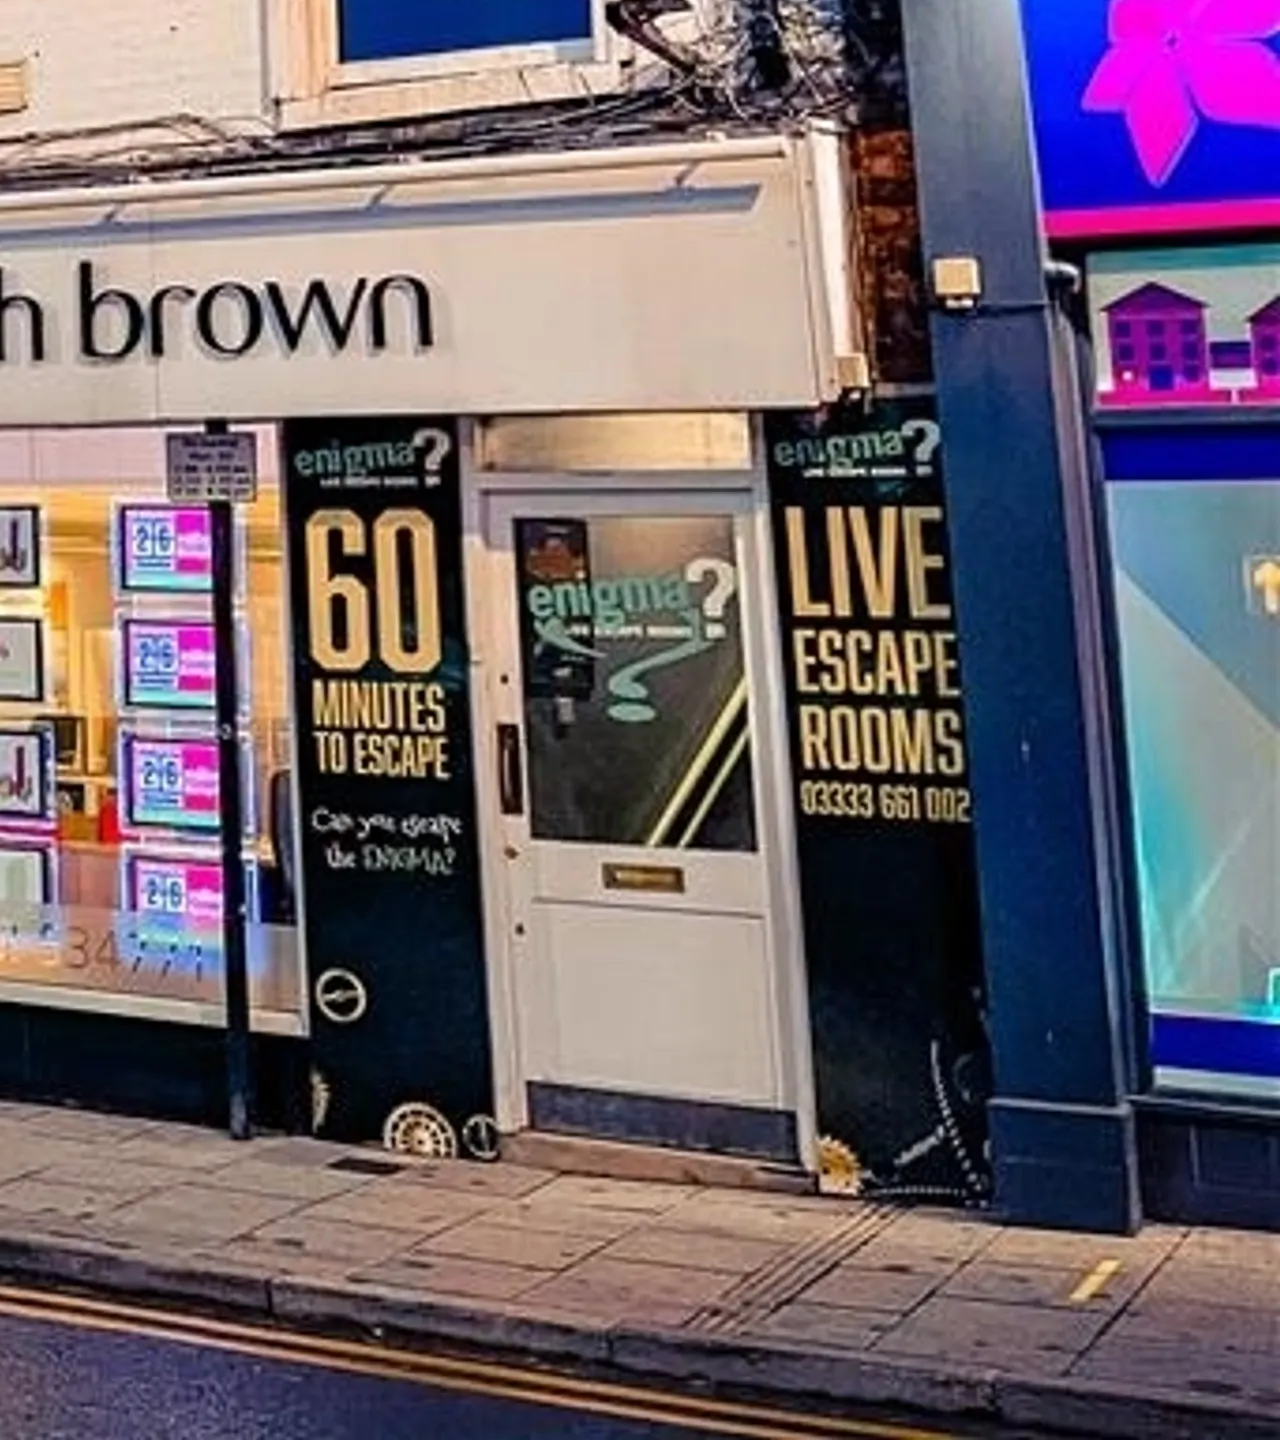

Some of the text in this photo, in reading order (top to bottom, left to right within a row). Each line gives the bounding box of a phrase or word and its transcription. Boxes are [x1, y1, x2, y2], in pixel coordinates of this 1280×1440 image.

[78, 259, 435, 360] brown
[294, 427, 451, 486] enigma?
[304, 507, 442, 674] 60
[783, 505, 952, 621] LIVE
[528, 558, 735, 640] enigma?
[793, 628, 961, 697] ESCAPE
[312, 679, 446, 733] MINUTES
[798, 704, 965, 775] ROOMS
[313, 731, 453, 781] TO ESCAPE
[800, 781, 875, 817] 03333
[879, 783, 921, 820] 661
